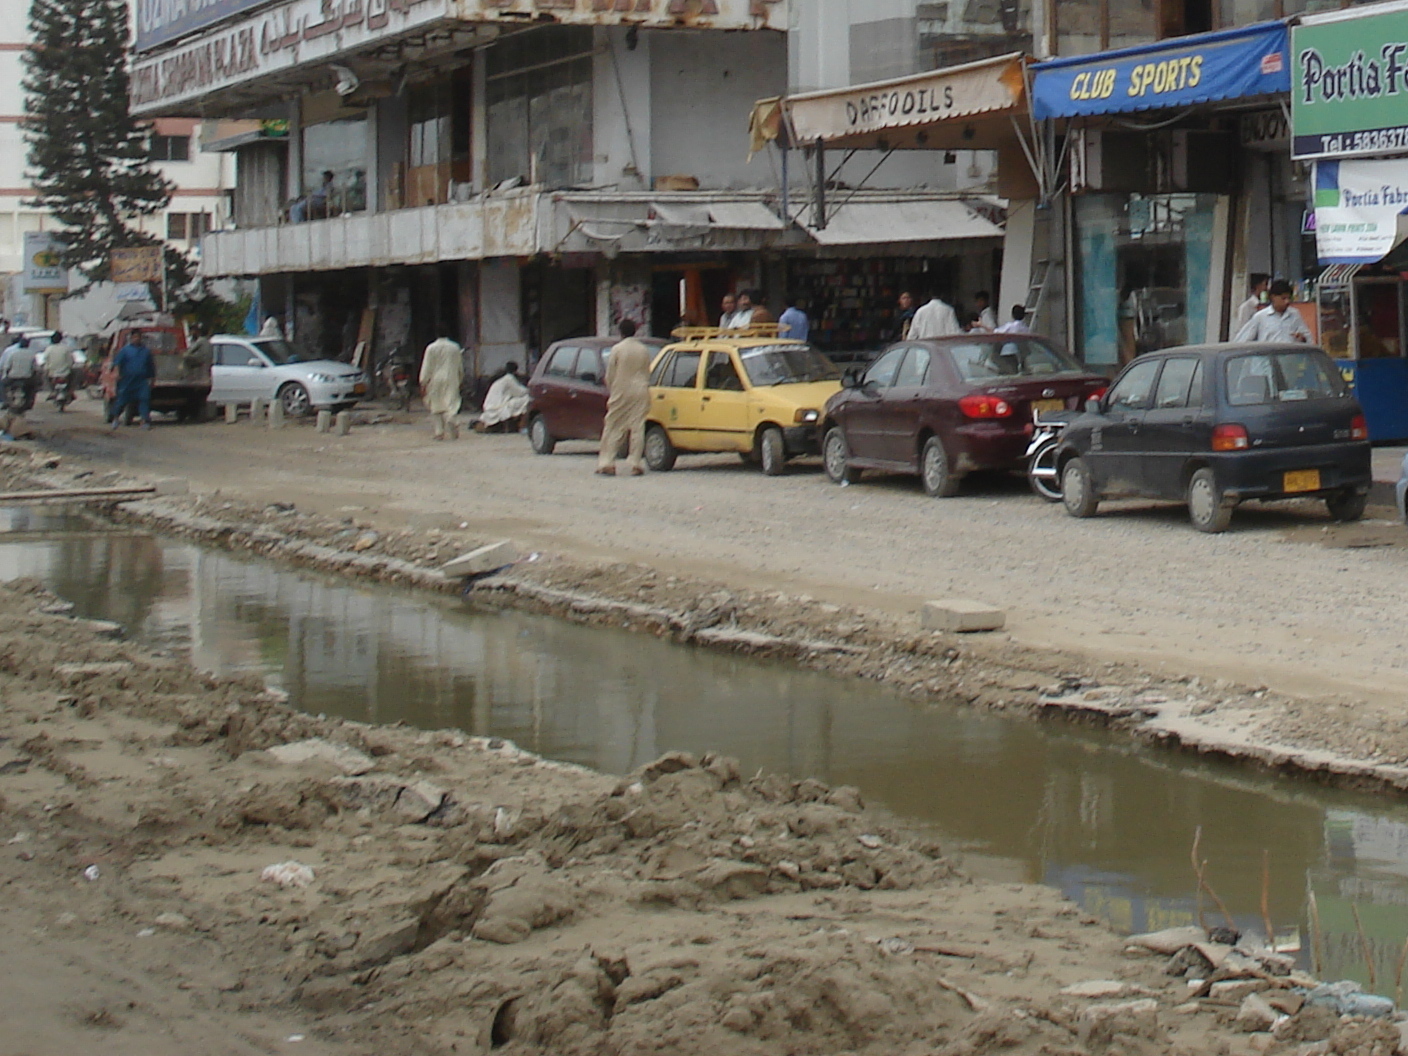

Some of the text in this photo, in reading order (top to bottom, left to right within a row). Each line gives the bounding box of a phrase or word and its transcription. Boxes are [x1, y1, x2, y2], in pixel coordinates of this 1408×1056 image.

[1069, 54, 1203, 101] CLUB SPORTS
[1301, 47, 1382, 105] Portia
[846, 85, 954, 126] DAFFODILS
[1342, 187, 1379, 209] Portia
